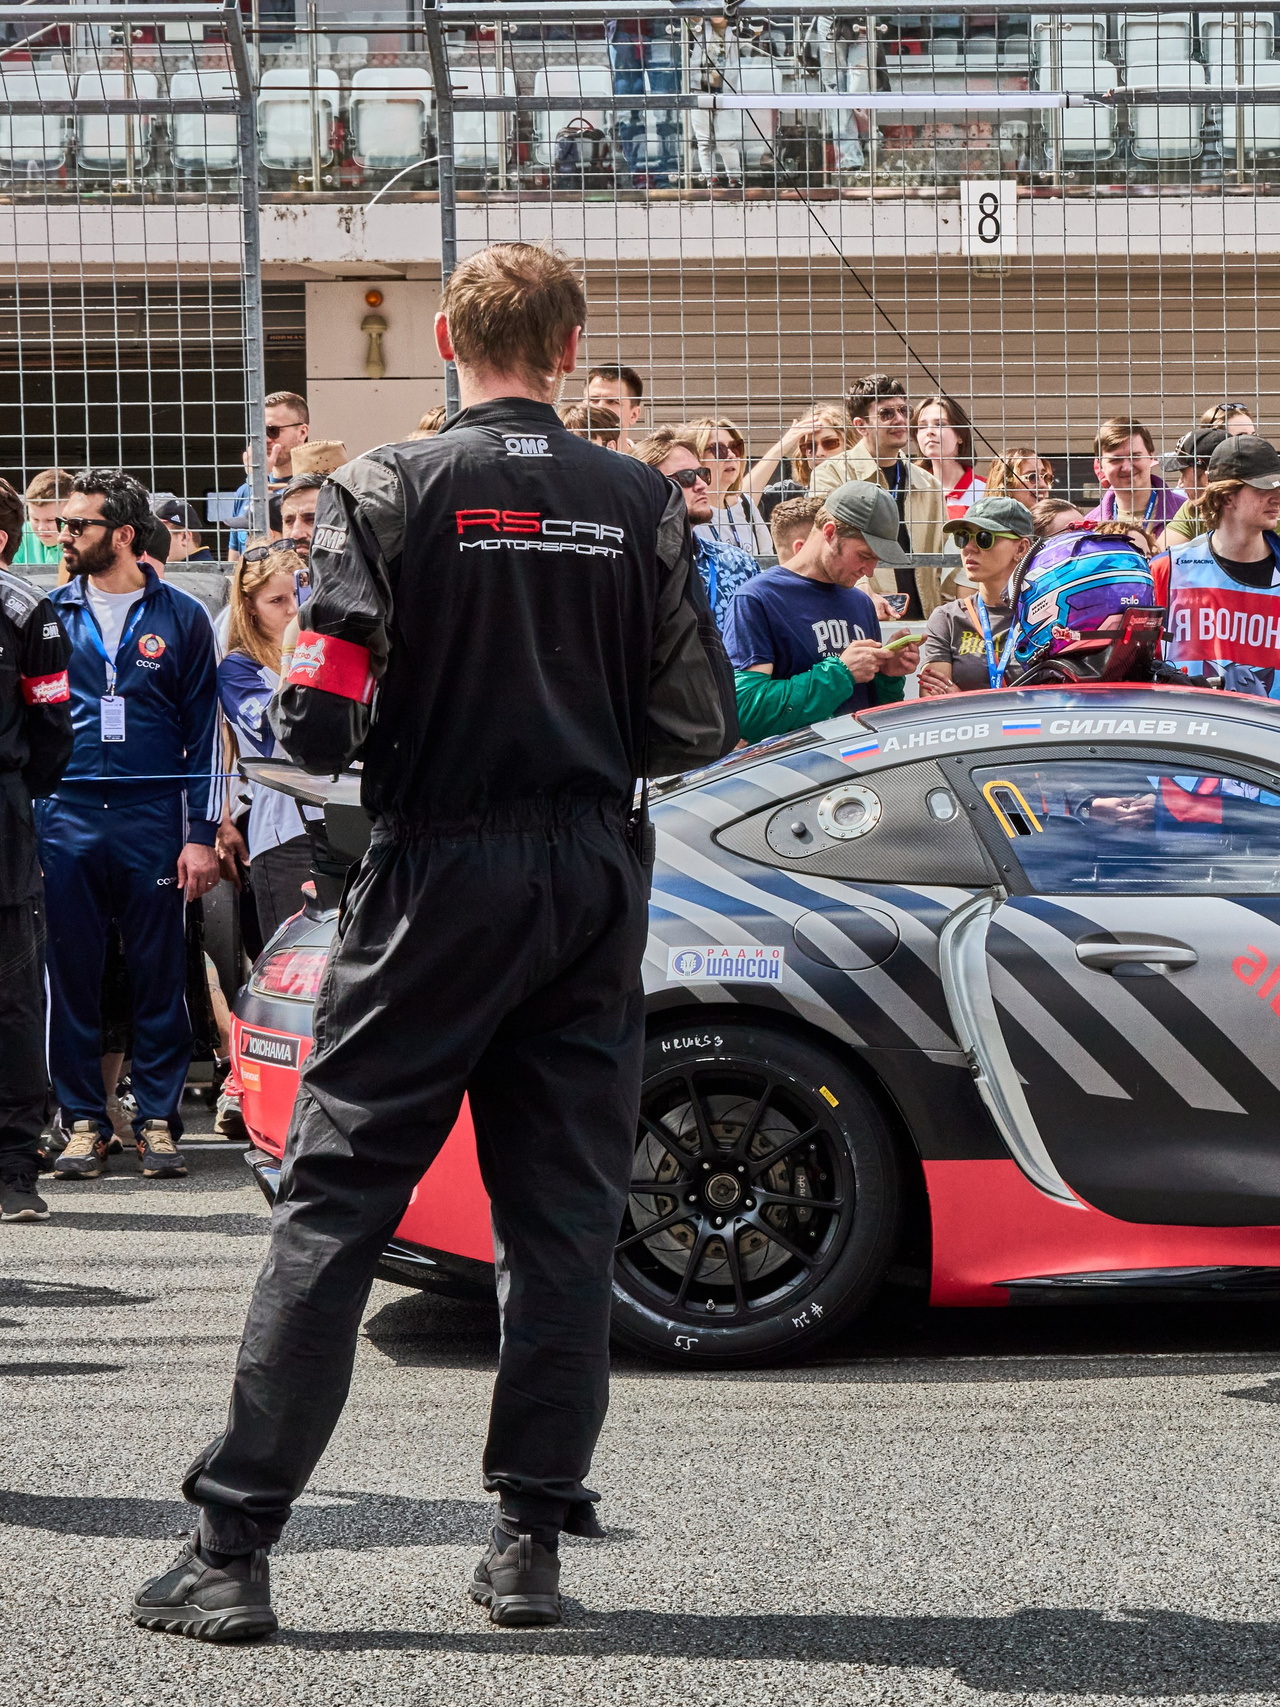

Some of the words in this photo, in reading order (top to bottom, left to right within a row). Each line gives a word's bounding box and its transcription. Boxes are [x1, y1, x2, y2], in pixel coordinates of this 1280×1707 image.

[978, 192, 1000, 244] 8
[505, 438, 549, 454] OMP
[314, 528, 347, 550] OMP
[459, 539, 624, 559] MOTORSPORT
[1175, 609, 1191, 642] Я
[884, 723, 990, 752] А.НЕСОВ
[1049, 720, 1178, 735] СИЛАЕВ
[1187, 722, 1218, 736] Н.
[707, 948, 780, 958] РАДИО
[706, 958, 779, 979] ШАНСОН
[249, 1036, 292, 1061] YOKOHAMA
